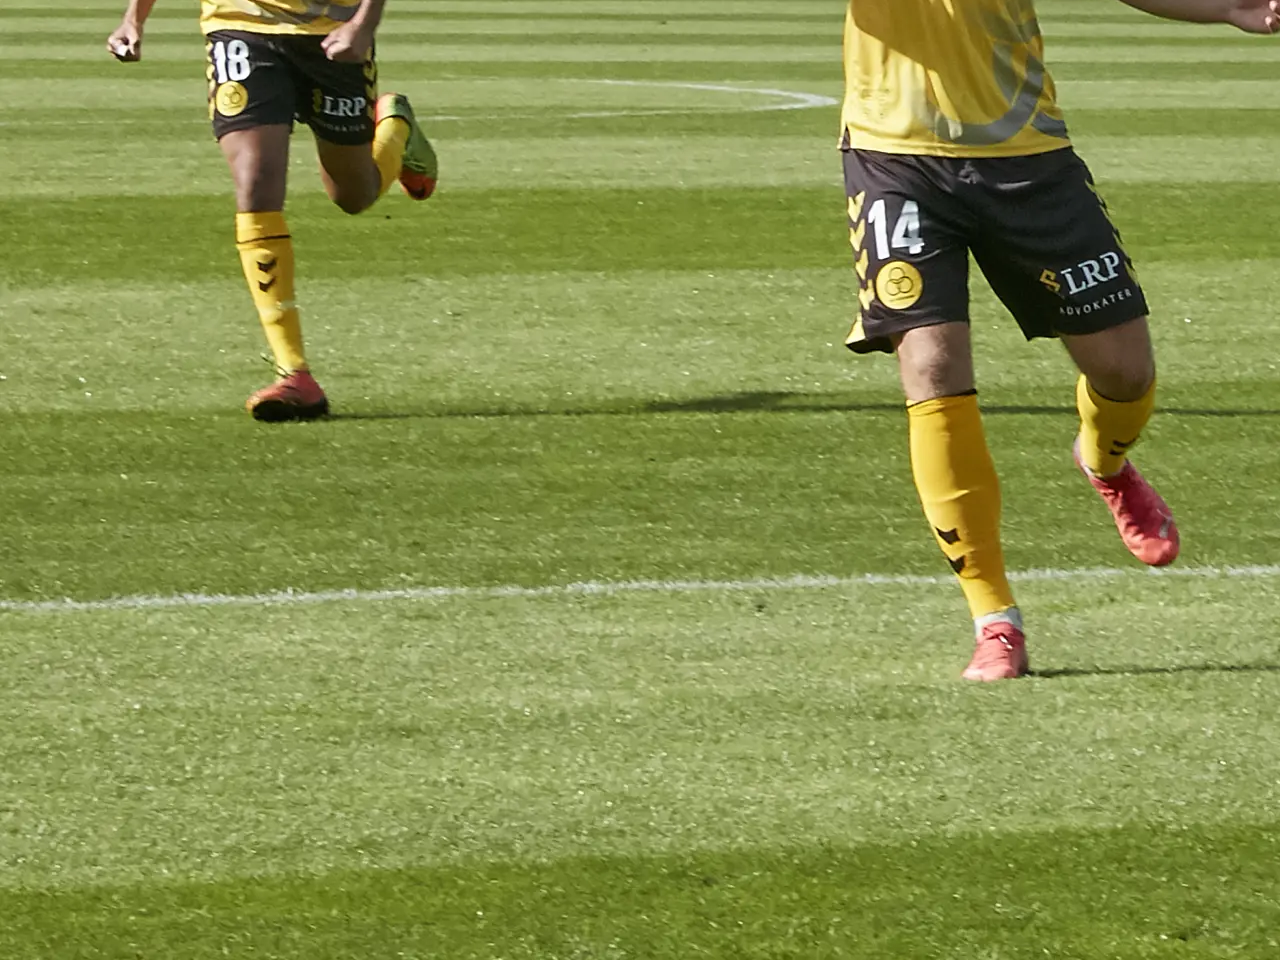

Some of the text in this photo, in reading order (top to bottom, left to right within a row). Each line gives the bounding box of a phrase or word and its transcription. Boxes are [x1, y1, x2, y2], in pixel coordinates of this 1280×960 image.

[213, 40, 251, 83] 18
[323, 95, 367, 117] LRP
[868, 199, 925, 260] 14
[1060, 251, 1121, 295] LRP
[1058, 288, 1132, 316] ADVOKATER
